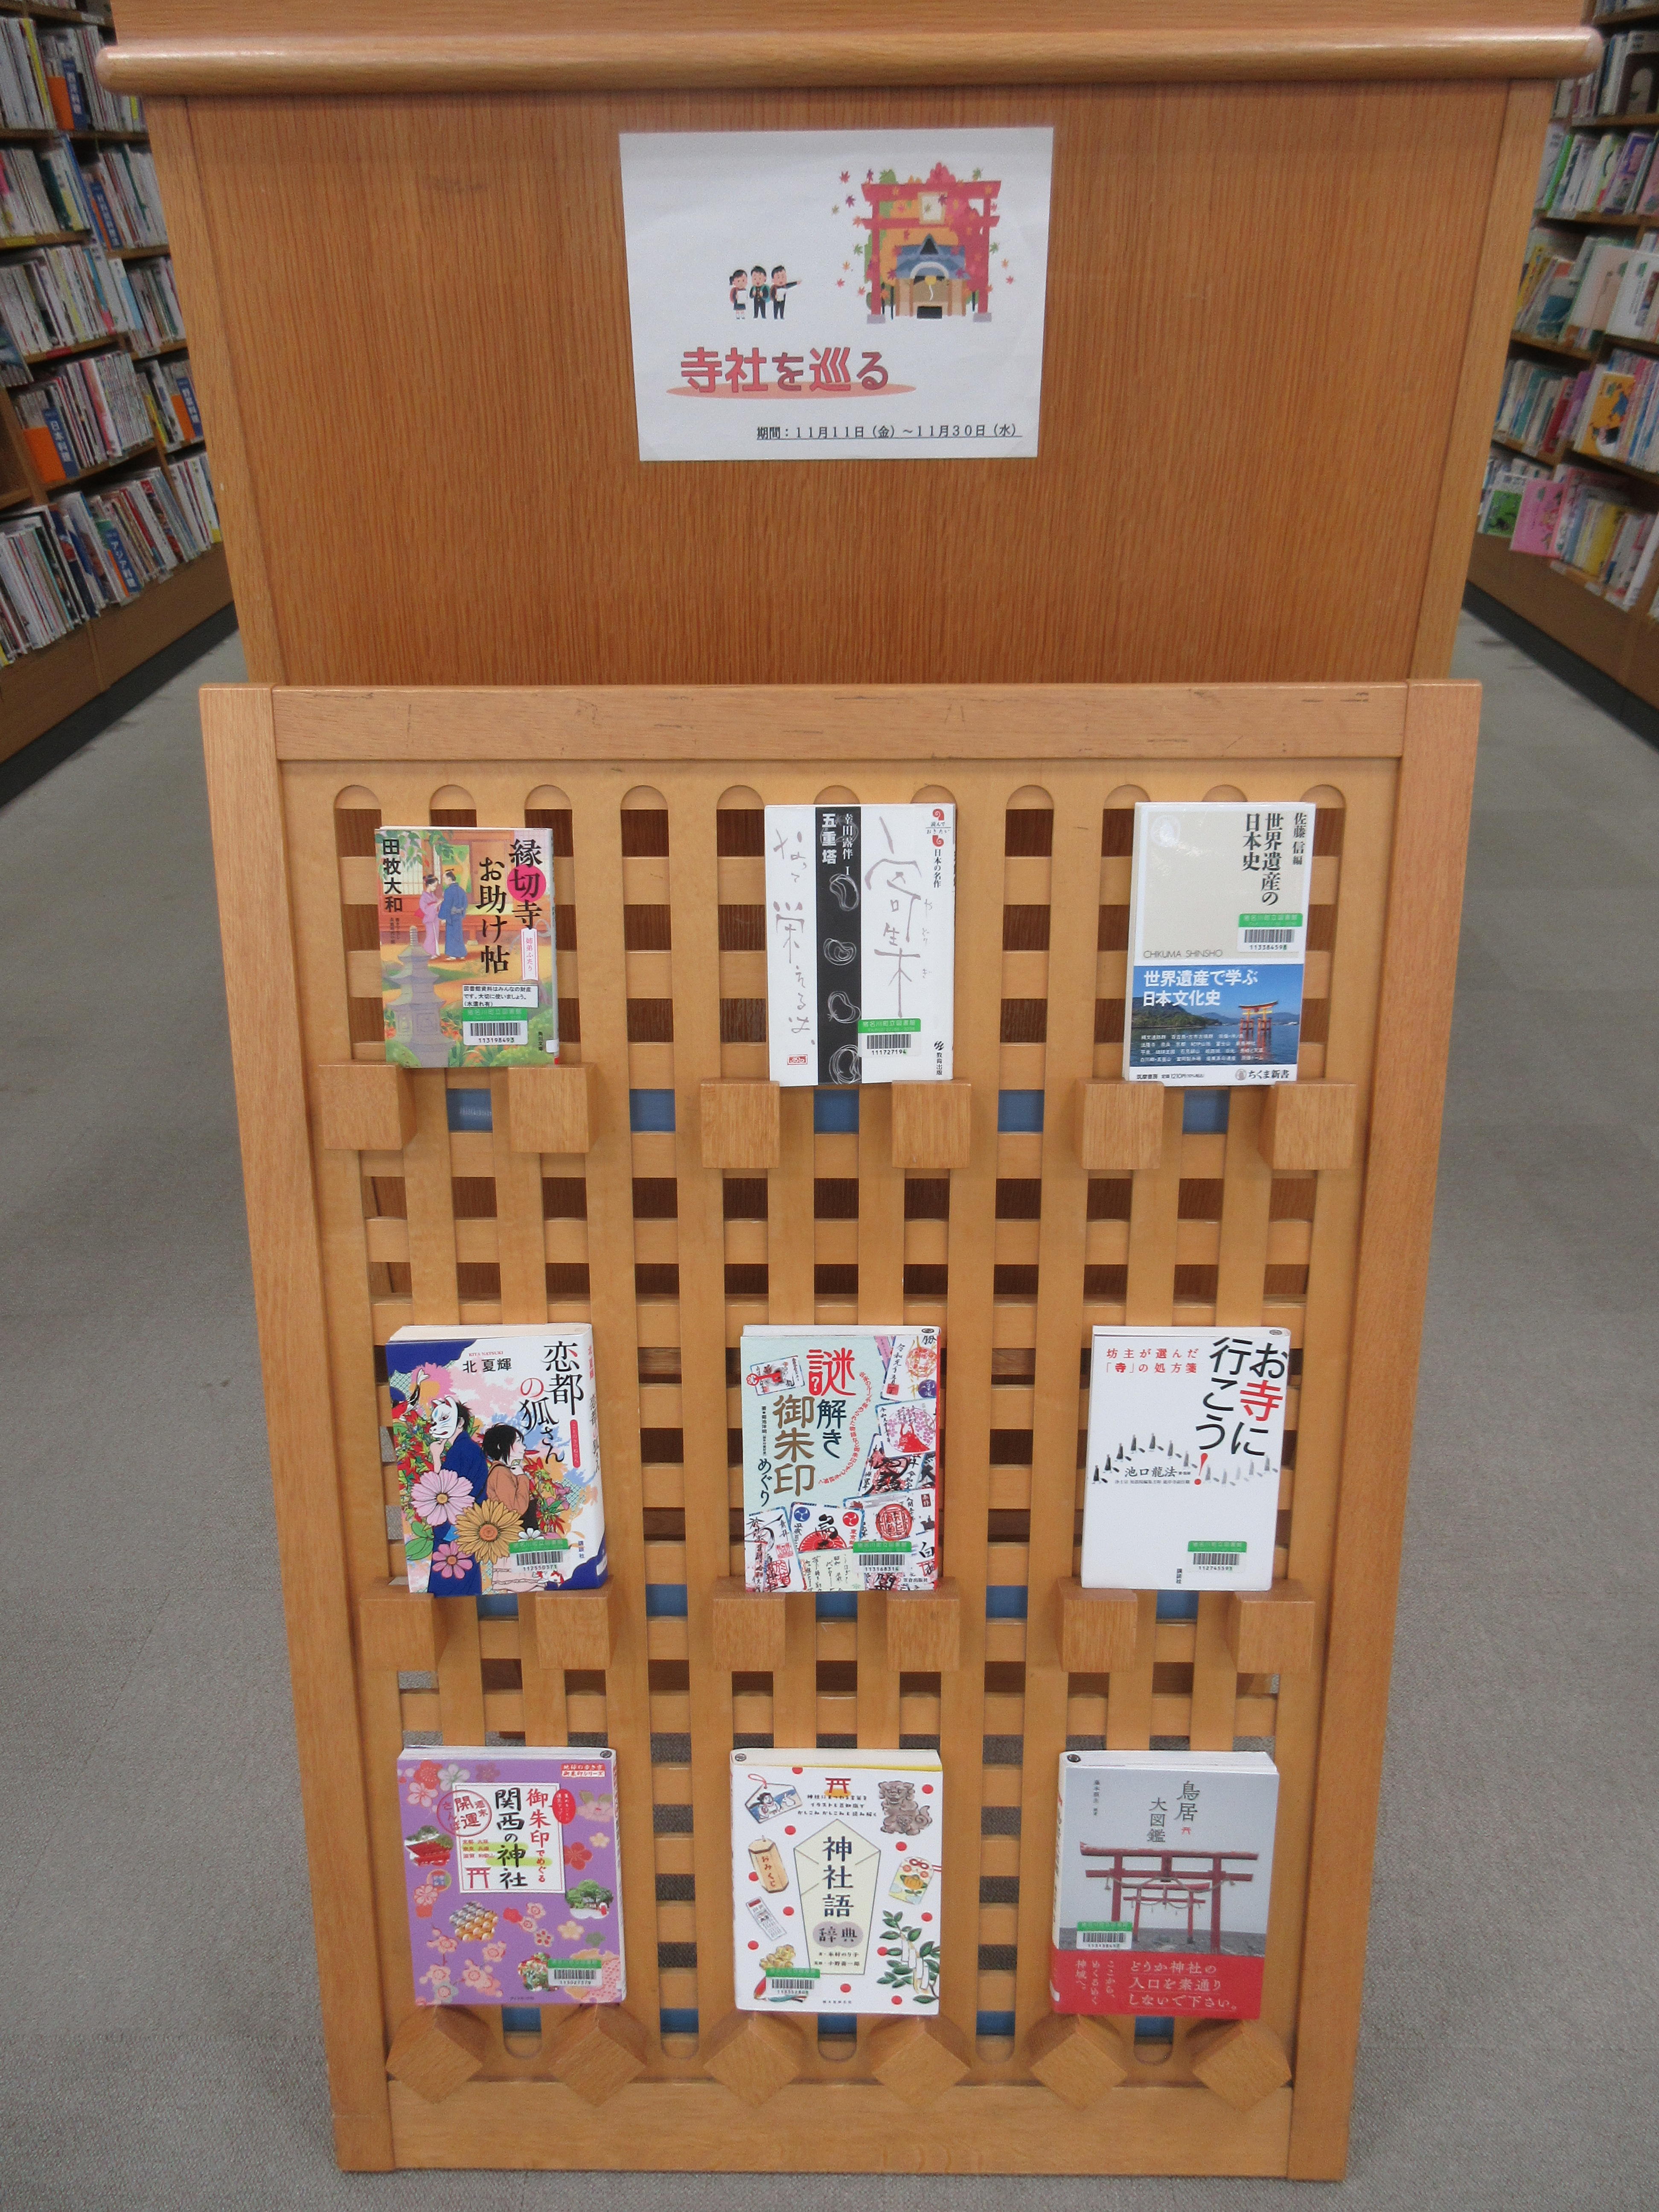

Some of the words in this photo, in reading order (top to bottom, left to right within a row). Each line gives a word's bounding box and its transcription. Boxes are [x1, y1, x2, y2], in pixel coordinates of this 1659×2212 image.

[681, 346, 888, 393] 寺社を巡る
[822, 814, 837, 864] 五重塔
[842, 813, 853, 860] 幸田露伴
[1242, 813, 1262, 871] 日本史
[384, 839, 402, 912] 田牧大和
[934, 849, 942, 888] 日本の名作
[1262, 813, 1284, 906] 世界遺産の
[509, 839, 543, 930] 縁切寺
[476, 857, 510, 974] お助け帖
[525, 937, 533, 972] 姉弟ふたり
[1143, 950, 1182, 958] CHIKUMA
[1186, 949, 1223, 958] SHINSHO
[1143, 989, 1221, 1007] 日本文化史
[1144, 969, 1258, 987] 世界遺産で学ぶ
[1249, 1069, 1289, 1079] ちくま新書
[1106, 1348, 1199, 1359] 坊主が選んだ
[1106, 1362, 1196, 1373] 「寺」の処方箋
[541, 1341, 584, 1415] 恋都
[1231, 1342, 1288, 1456] お寺に
[773, 1395, 815, 1497] 御朱印
[758, 1458, 772, 1507] めぐり
[1125, 1466, 1177, 1477] 池口龍法
[454, 1796, 481, 1829] 開運
[474, 1800, 488, 1817] 週末
[1147, 1797, 1168, 1843] 大図鑑
[1174, 1780, 1200, 1822] 鳥居
[495, 1787, 528, 1889] 関西の神社
[526, 1788, 551, 1883] 御朱印でめぐる
[761, 1856, 776, 1887] おみくじ
[822, 1836, 854, 1917] 神社語
[819, 1926, 858, 1943] 辞典
[1129, 1977, 1221, 1992] 入口を素通り
[1130, 1960, 1217, 1974] どうか神社の
[1129, 1994, 1237, 2011] しないで下さい。
